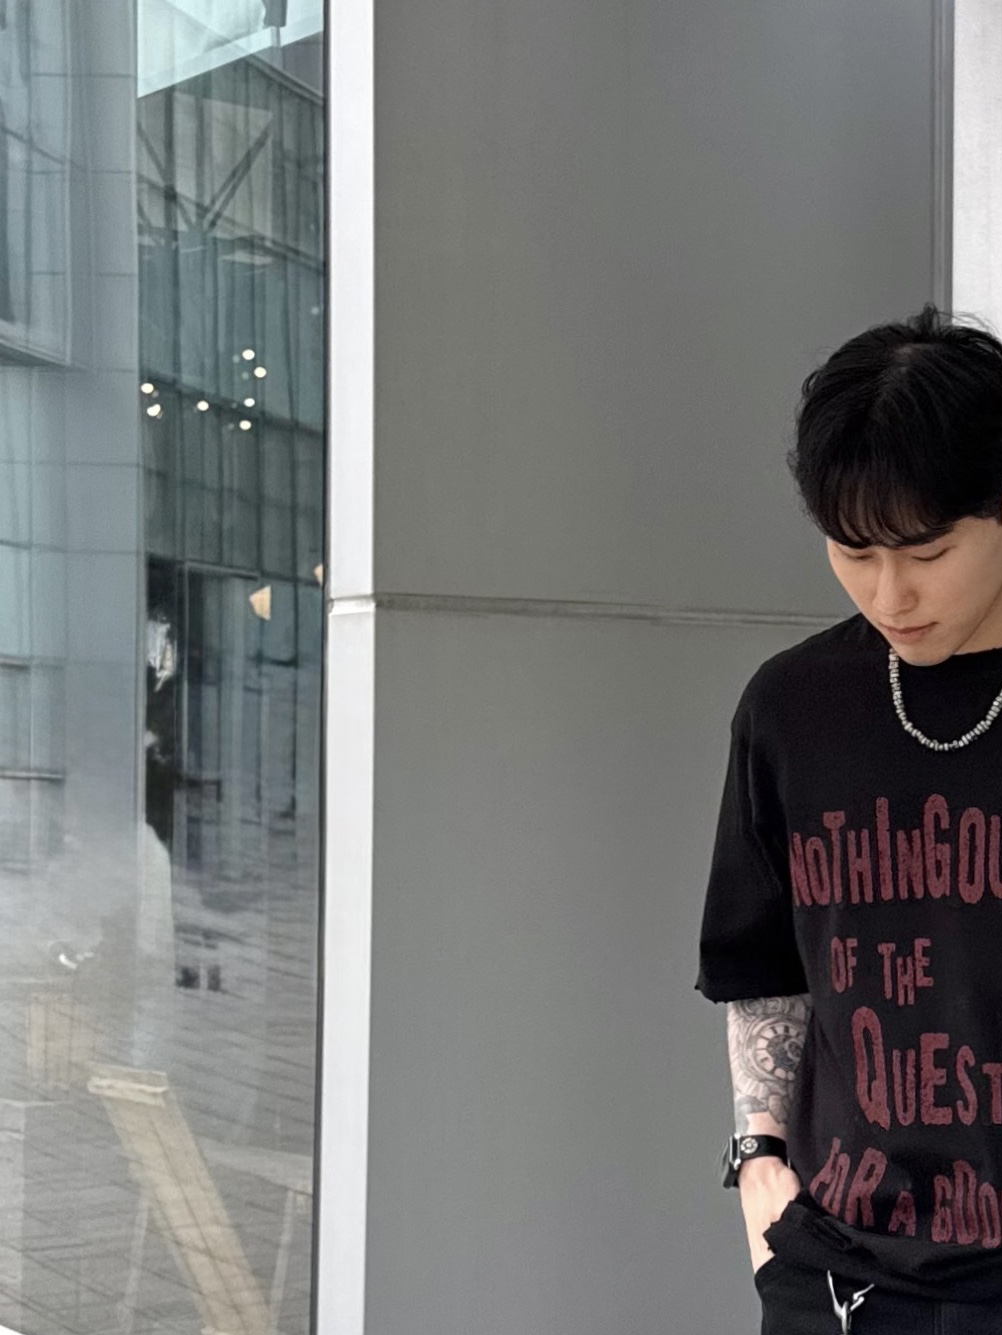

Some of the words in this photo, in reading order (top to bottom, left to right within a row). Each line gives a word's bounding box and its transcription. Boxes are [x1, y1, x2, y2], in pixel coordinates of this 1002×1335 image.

[830, 936, 858, 993] OF
[878, 937, 934, 1006] THE
[888, 1190, 918, 1237] A
